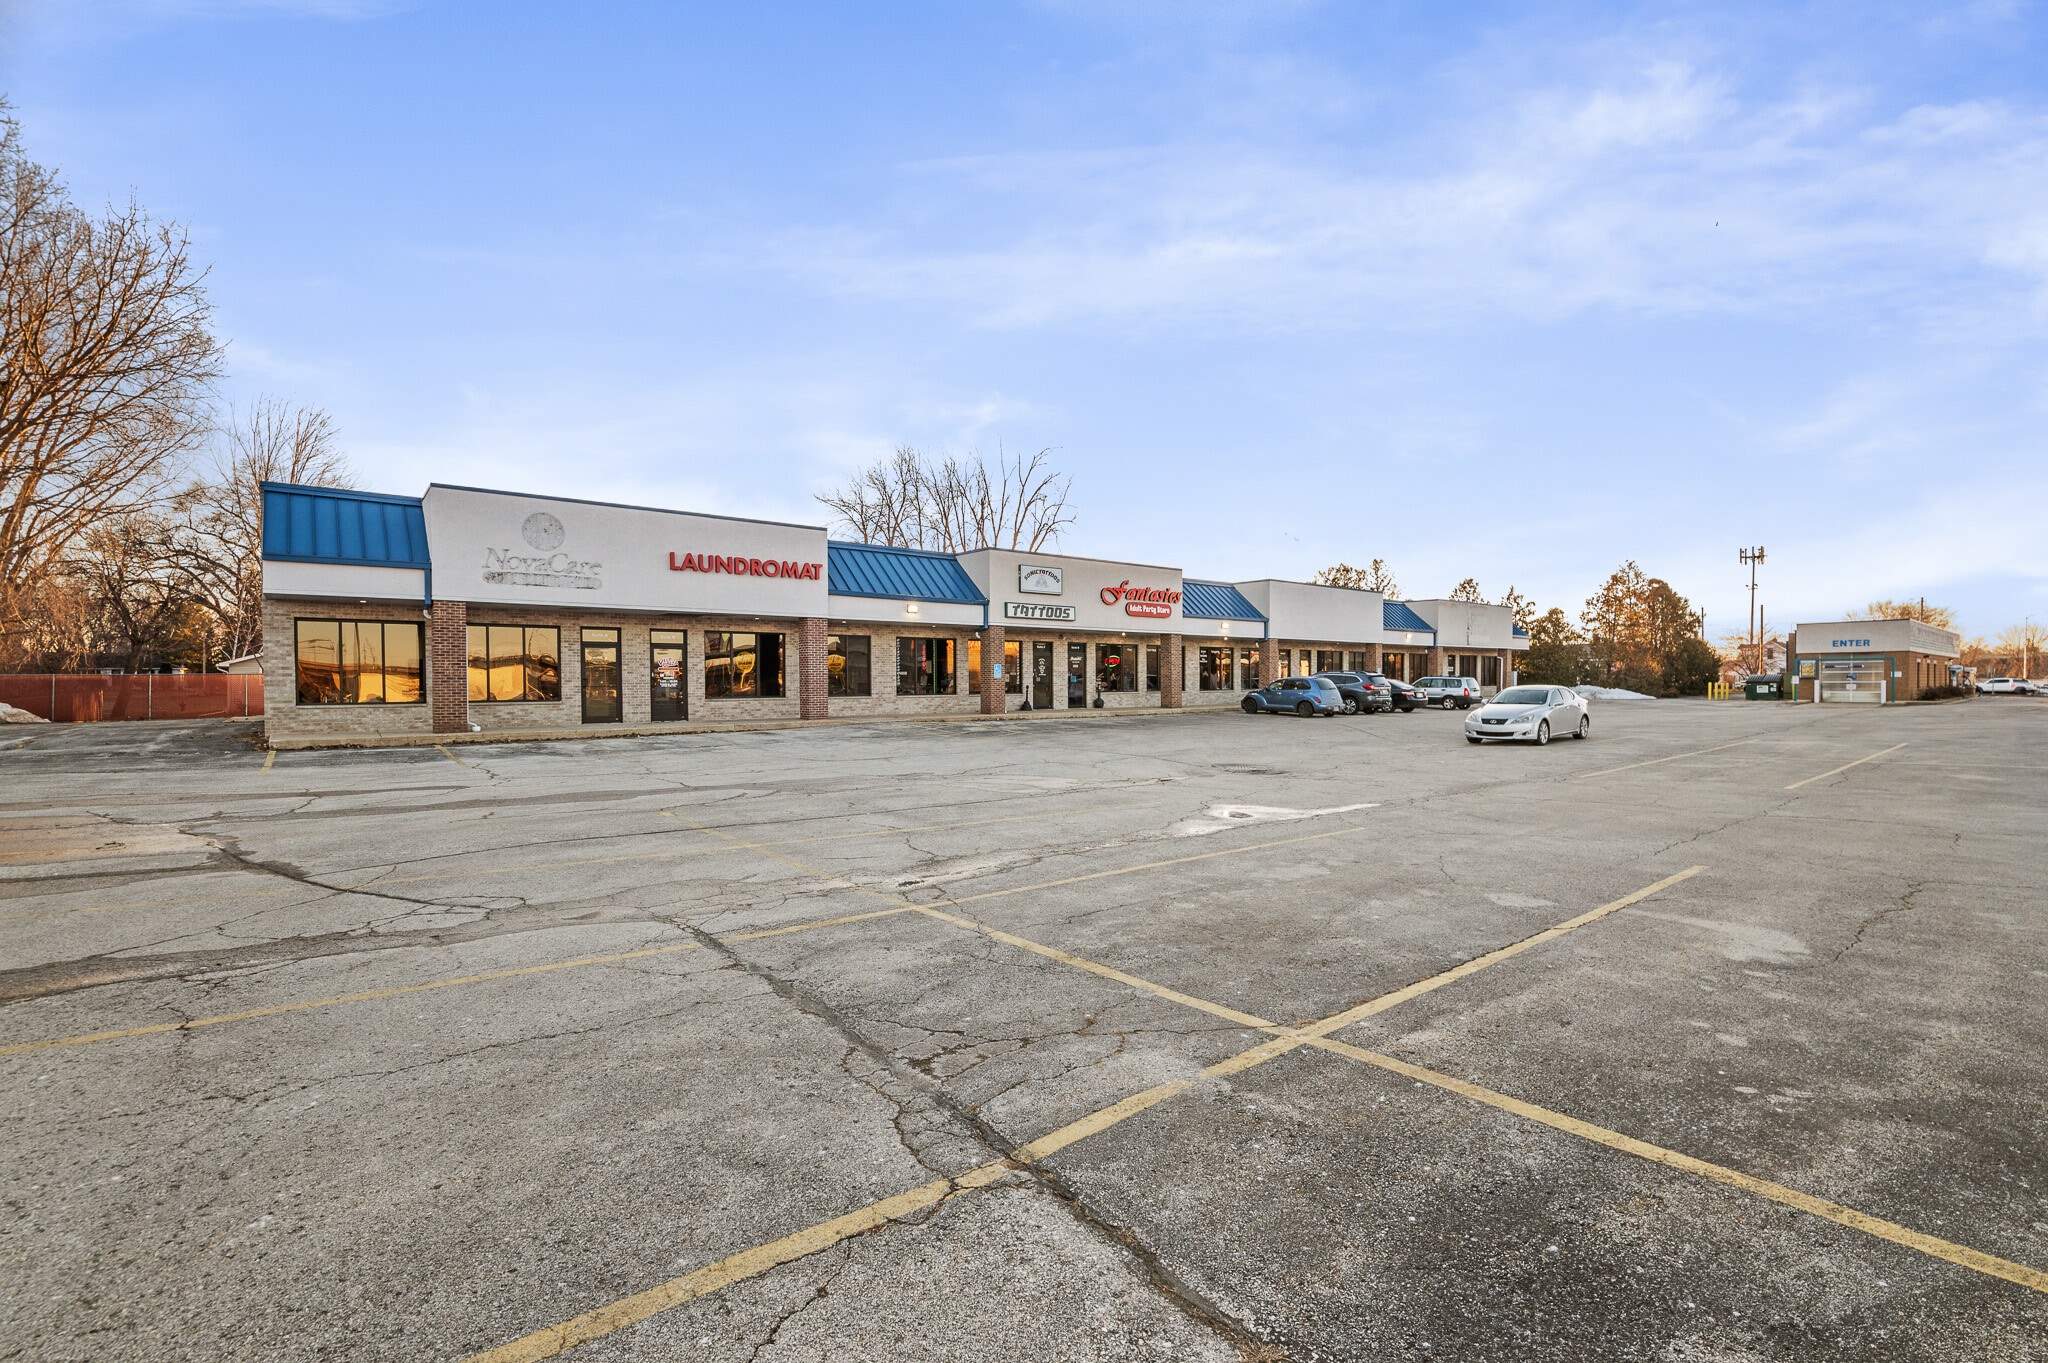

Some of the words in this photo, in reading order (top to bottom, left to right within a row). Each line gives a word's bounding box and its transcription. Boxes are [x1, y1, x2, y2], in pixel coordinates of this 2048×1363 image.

[482, 547, 602, 575] NovaCare
[669, 551, 823, 580] LAUNDROMAT
[1100, 580, 1182, 605] Fantasies
[1012, 604, 1071, 618] TATTOOS
[1129, 604, 1142, 612] Adult
[1143, 605, 1156, 614] Party
[1157, 606, 1170, 614] Store
[1832, 639, 1870, 647] ENTER
